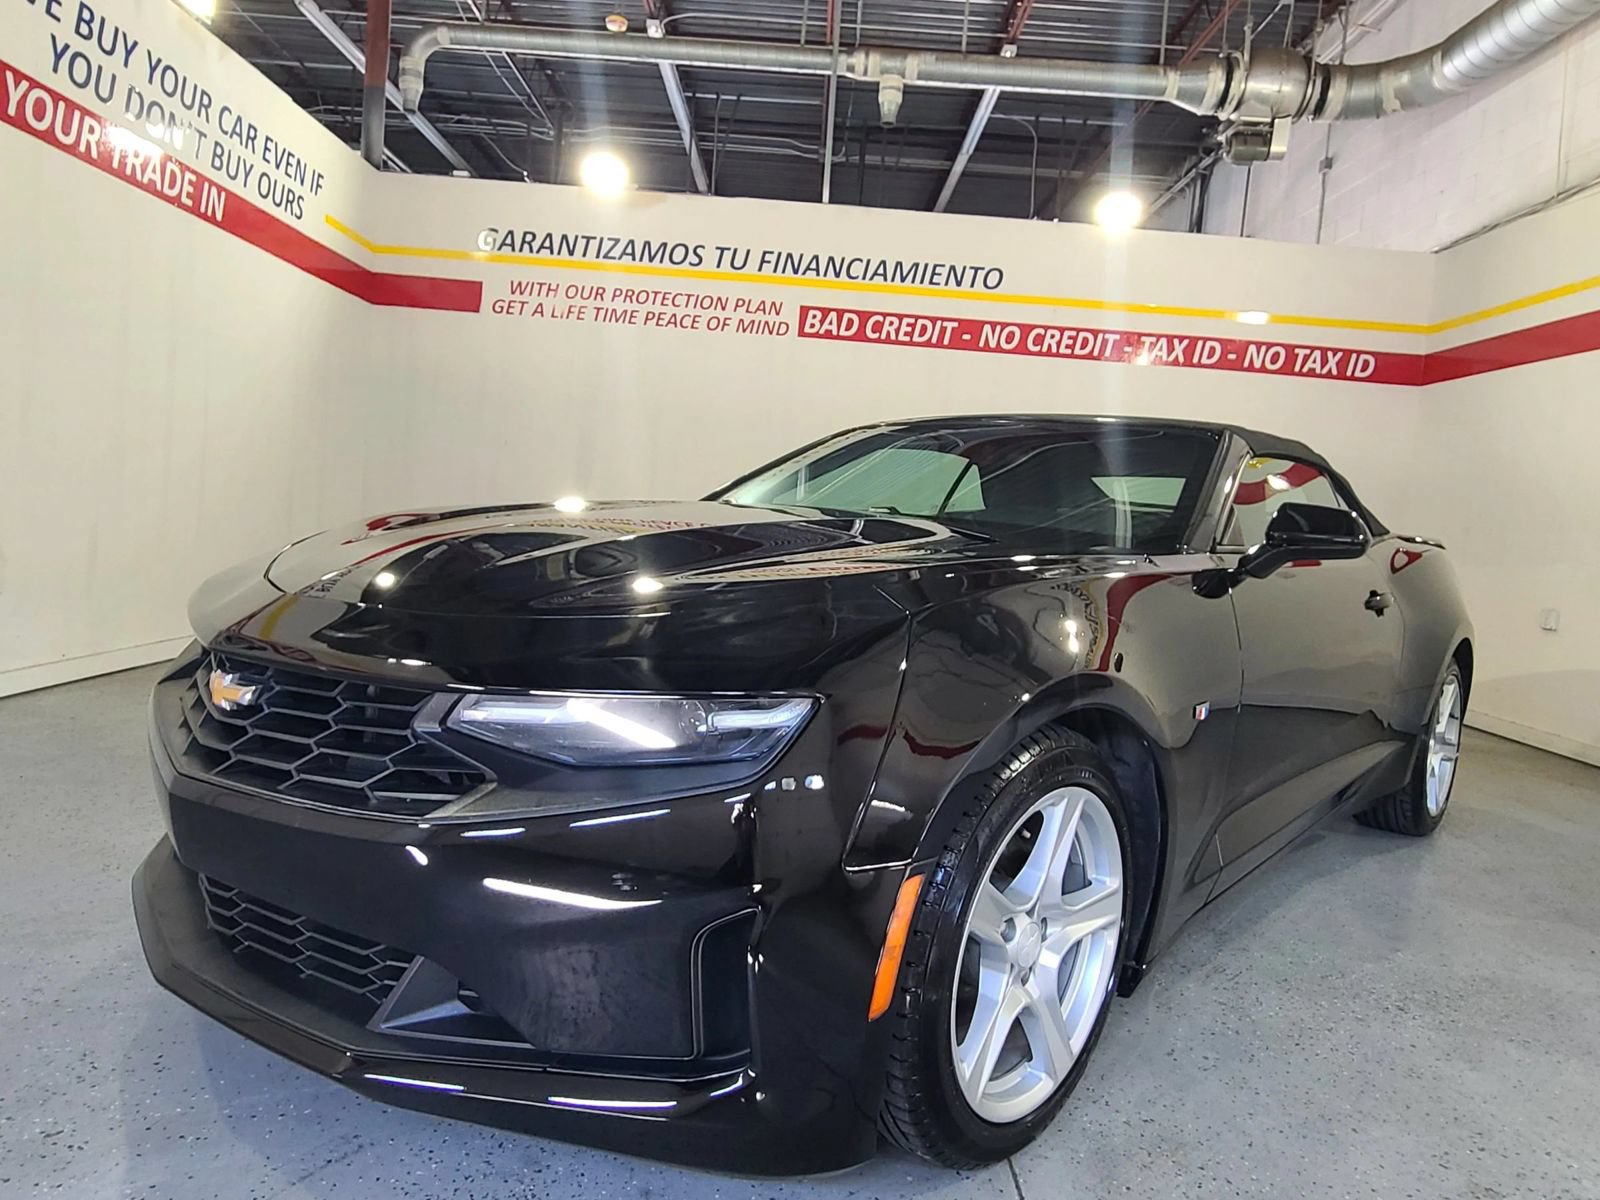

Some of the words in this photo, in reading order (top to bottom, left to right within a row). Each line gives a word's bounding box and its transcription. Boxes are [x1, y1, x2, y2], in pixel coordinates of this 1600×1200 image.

[27, 0, 62, 23] E
[75, 1, 139, 69] BUY
[147, 49, 212, 124] YOUR
[218, 106, 257, 154] CAR
[262, 135, 307, 187] EVEN
[310, 169, 325, 197] IF
[50, 33, 117, 104] YOU
[211, 140, 254, 189] BUY
[257, 172, 305, 220] OURS
[5, 70, 101, 160] YOUR
[110, 128, 197, 207] TRADE
[200, 182, 226, 222] IN
[477, 228, 705, 267] GARANTIZAMOS
[714, 246, 750, 270] TU
[757, 251, 1004, 290] FINANCIAMIENTO
[492, 299, 529, 316] GET
[532, 302, 544, 318] A
[551, 304, 586, 320] LIFE
[593, 307, 638, 325] TIME
[643, 311, 701, 330] PEACE
[706, 316, 732, 332] OF
[736, 318, 790, 337] MIND
[510, 280, 560, 299] WITH
[564, 284, 606, 302] OUR
[611, 287, 728, 311] PROTECTION
[733, 297, 783, 316] PLAN
[803, 309, 860, 338] BAD
[865, 314, 958, 346] CREDIT
[978, 323, 1021, 350] NO
[1027, 327, 1120, 357] CREDIT
[1139, 335, 1190, 363] TAX
[1192, 343, 1222, 365] ID
[1243, 344, 1286, 370] NO
[1294, 347, 1344, 376] TAX
[1346, 356, 1376, 378] ID
